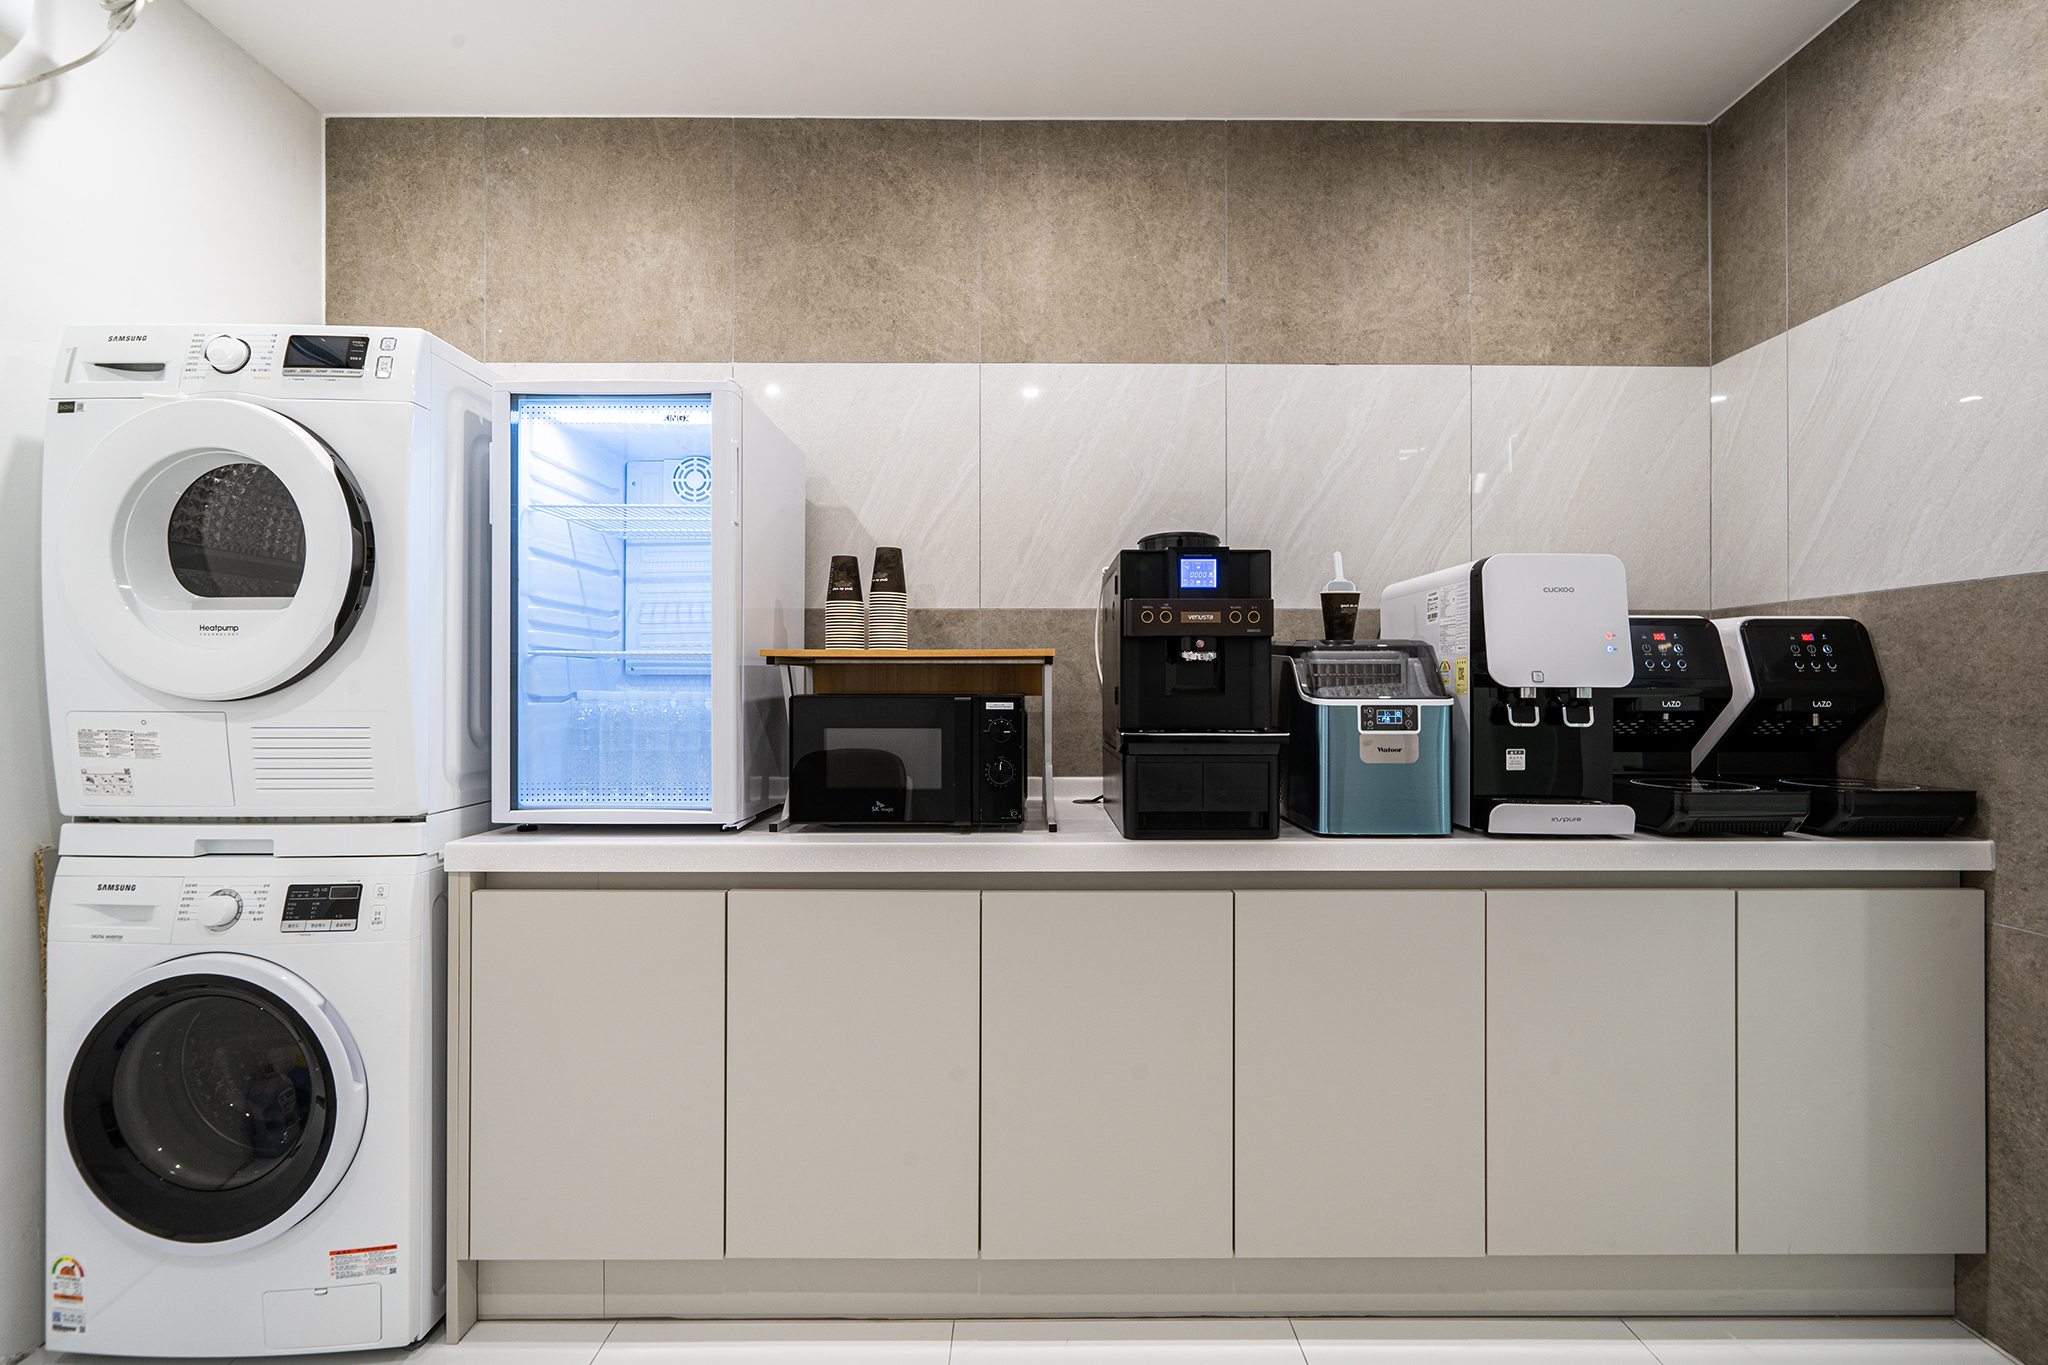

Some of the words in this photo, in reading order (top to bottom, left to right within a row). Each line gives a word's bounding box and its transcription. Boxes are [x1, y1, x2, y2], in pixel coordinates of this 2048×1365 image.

[1661, 700, 1682, 708] LAZO
[1812, 700, 1832, 708] LAZO
[97, 883, 137, 891] SAMSUNG
